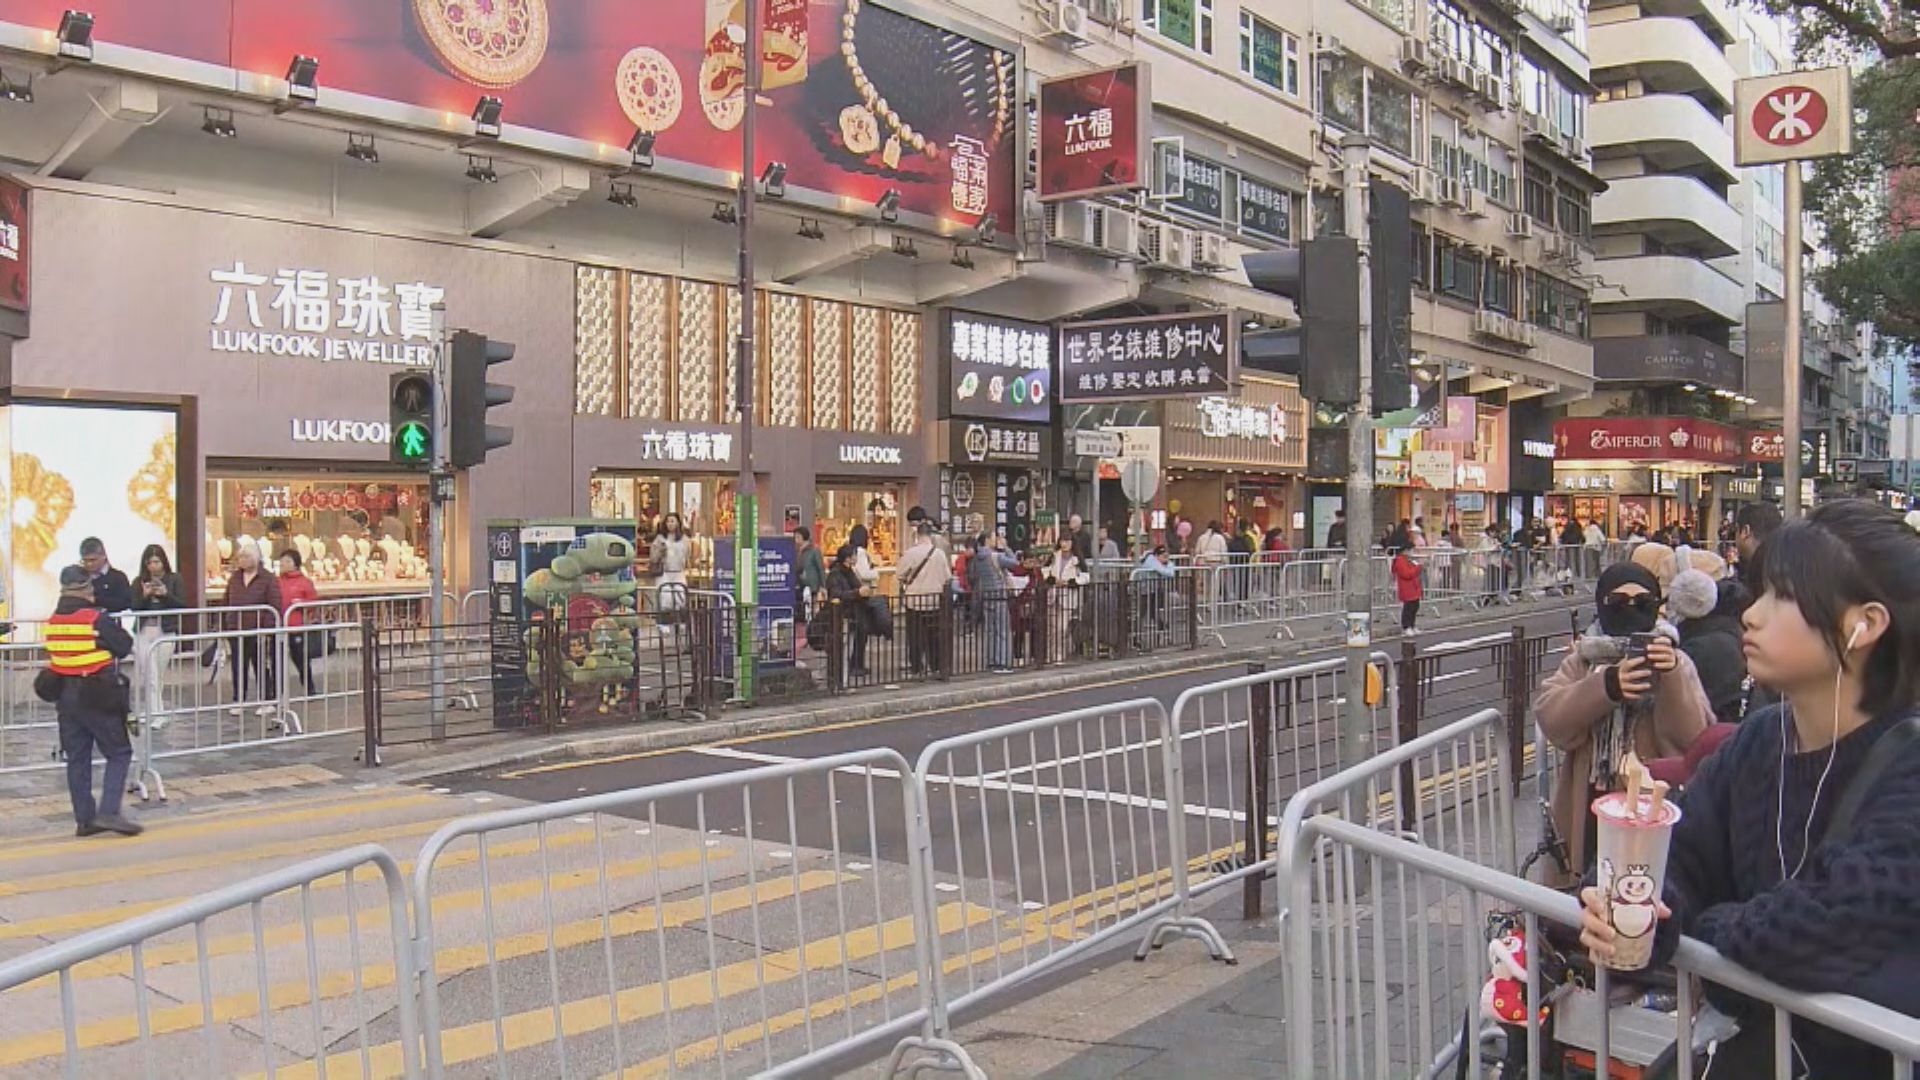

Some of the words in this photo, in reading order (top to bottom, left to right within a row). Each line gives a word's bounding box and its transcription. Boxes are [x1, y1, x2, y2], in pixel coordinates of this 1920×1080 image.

[1064, 108, 1112, 144] 六福
[1064, 138, 1112, 155] LUKFOOK
[210, 261, 445, 342] 六福珠寶
[211, 329, 321, 357] LUKFOOK
[1066, 322, 1225, 364] 世界名錶維修中心
[642, 428, 732, 463] 六福珠寶
[839, 444, 902, 465] LUKFOOK
[1590, 429, 1662, 449] EMPEROR
